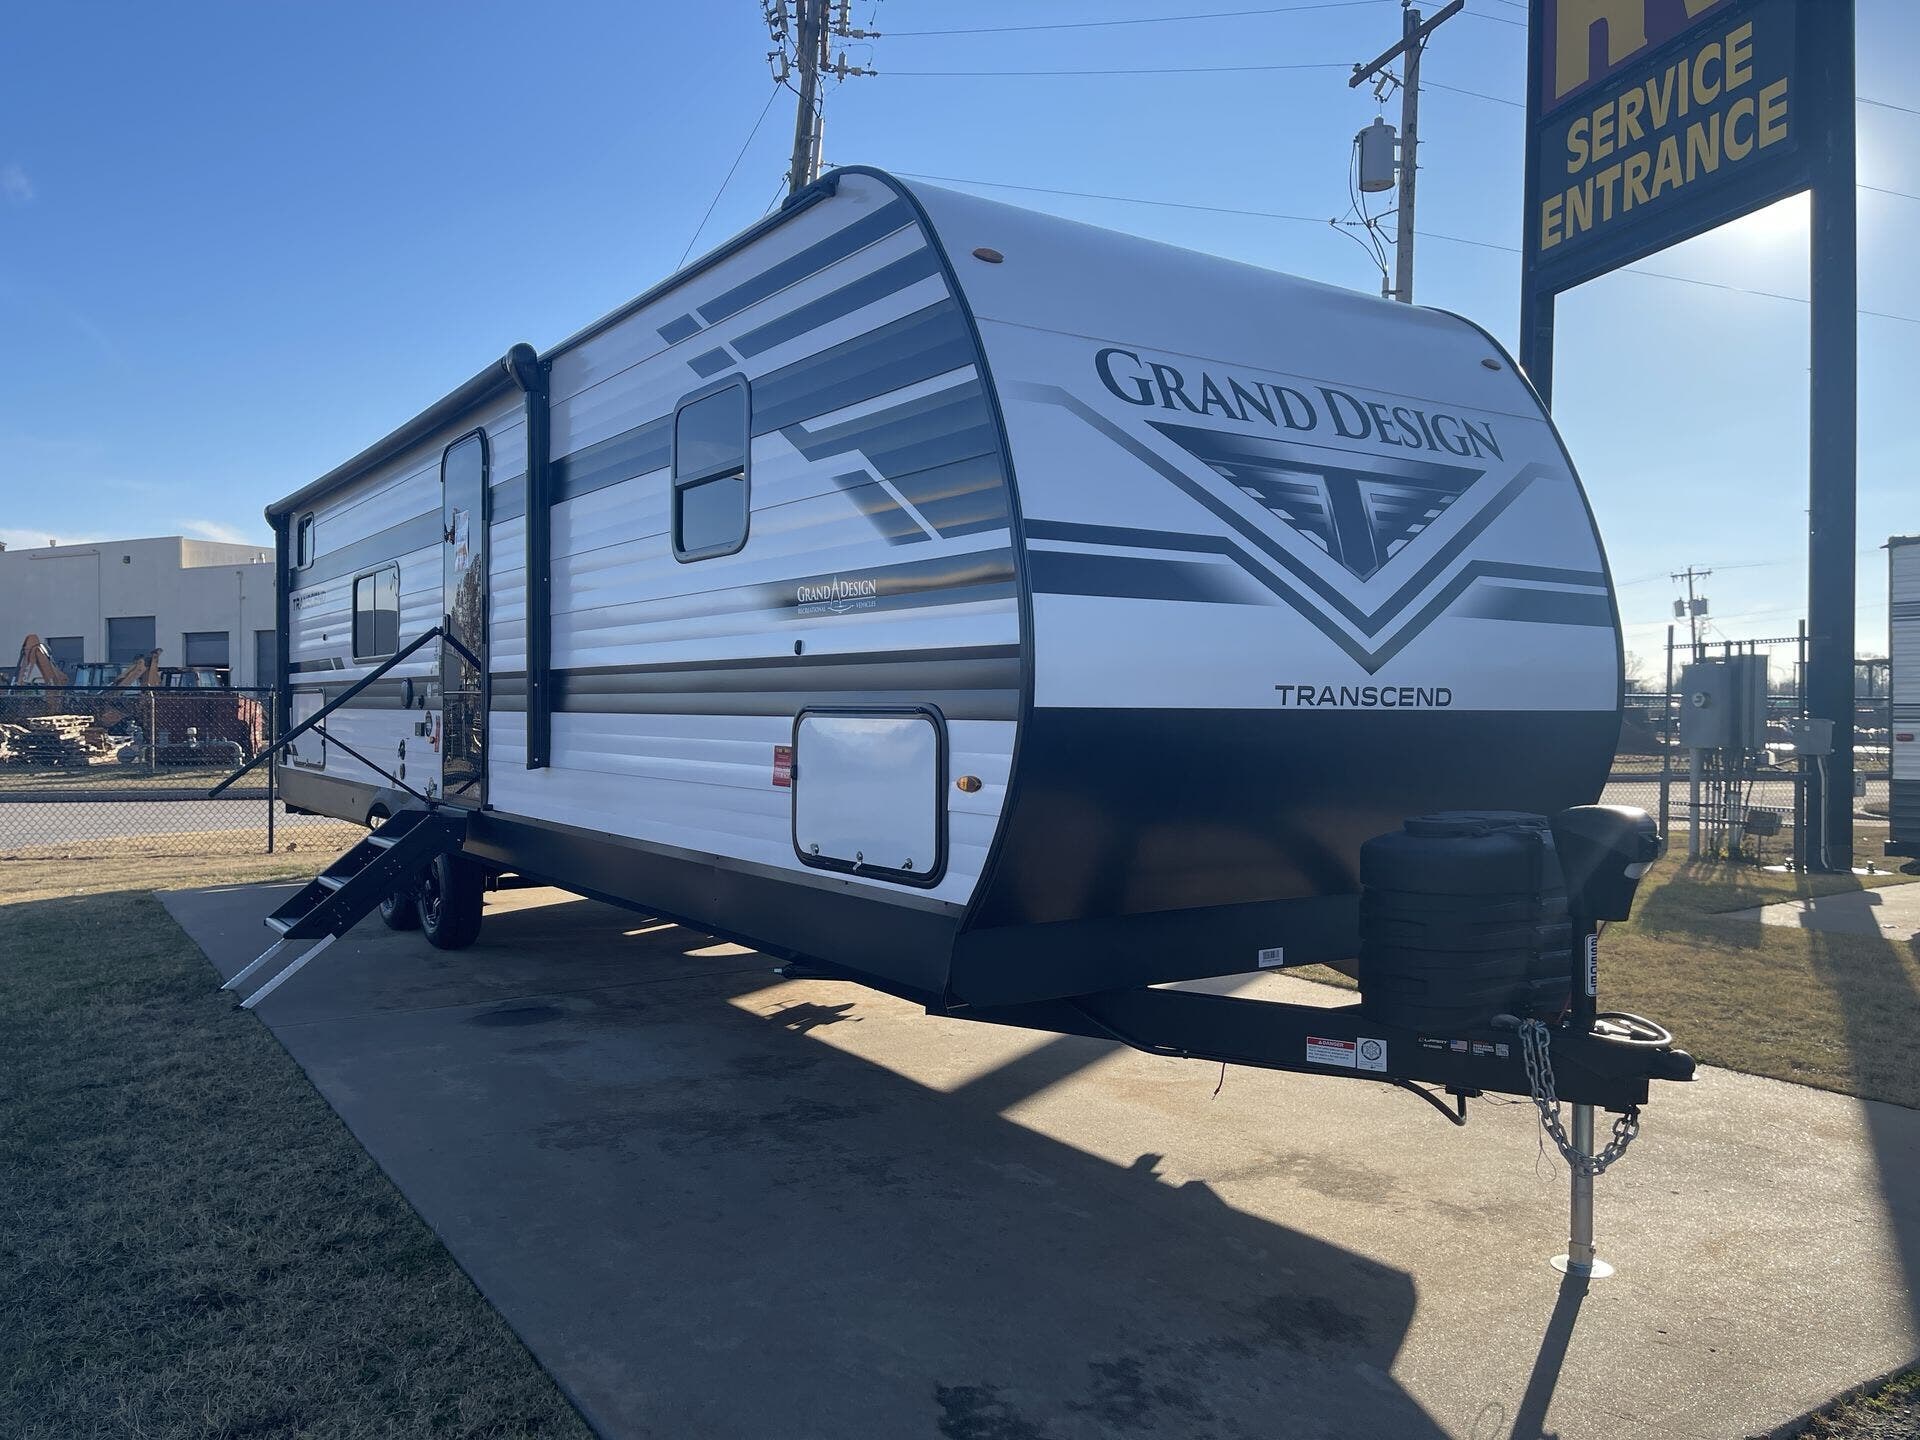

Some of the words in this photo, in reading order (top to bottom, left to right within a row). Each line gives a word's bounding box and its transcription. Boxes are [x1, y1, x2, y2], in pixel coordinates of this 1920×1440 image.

[1540, 77, 1788, 251] ENTRANCE
[1566, 20, 1753, 175] SERVICE
[1094, 347, 1318, 432] GRAND
[1315, 386, 1504, 462] DESIGN
[1275, 685, 1452, 707] TRANSCEND
